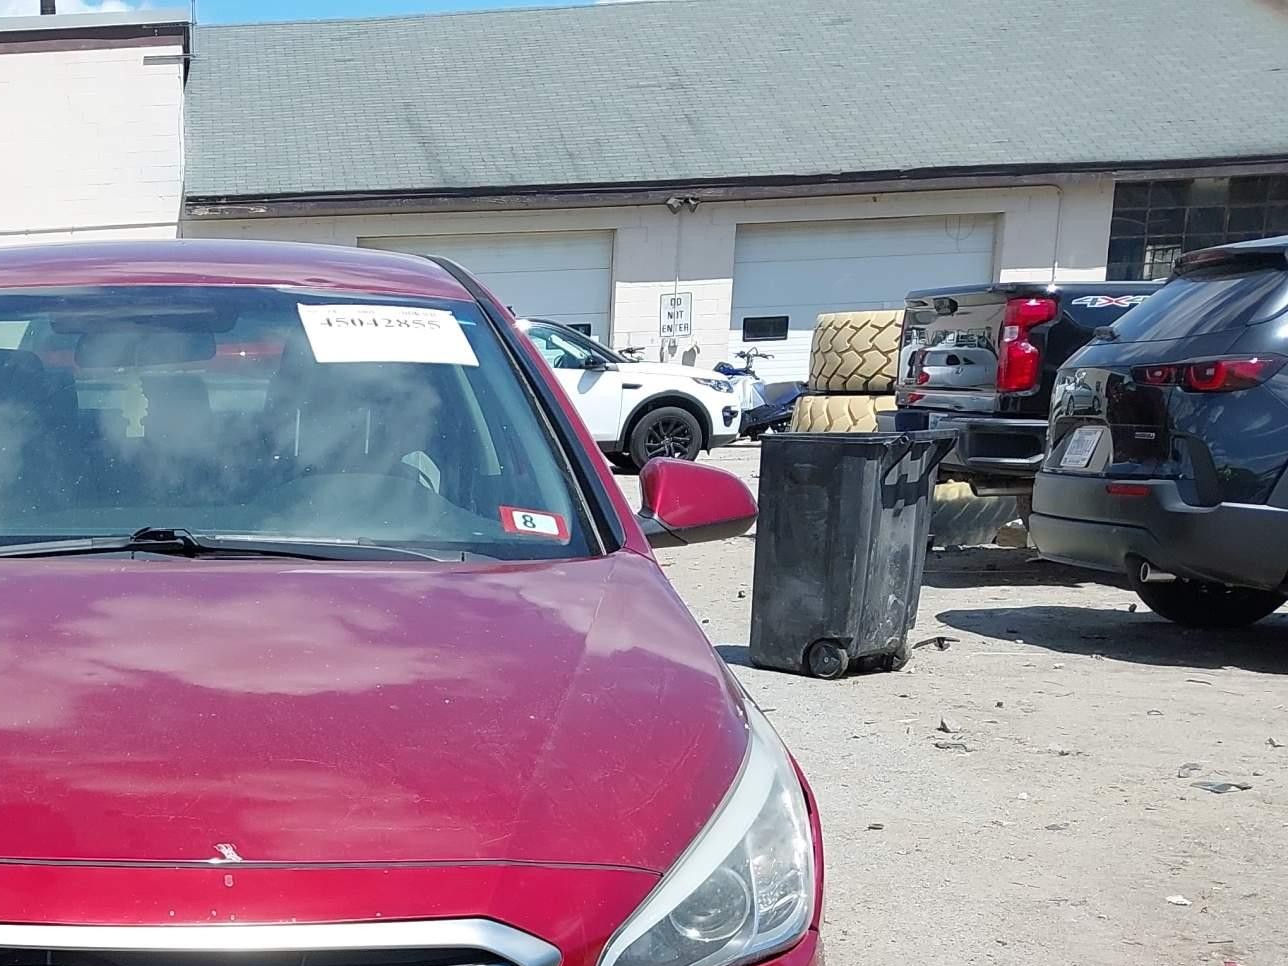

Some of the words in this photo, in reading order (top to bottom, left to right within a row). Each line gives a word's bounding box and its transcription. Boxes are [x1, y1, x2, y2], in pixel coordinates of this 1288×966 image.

[670, 297, 682, 306] DO
[668, 310, 684, 320] NOT
[320, 317, 441, 329] 45042855
[662, 323, 689, 333] ENTER
[522, 514, 536, 529] 8
